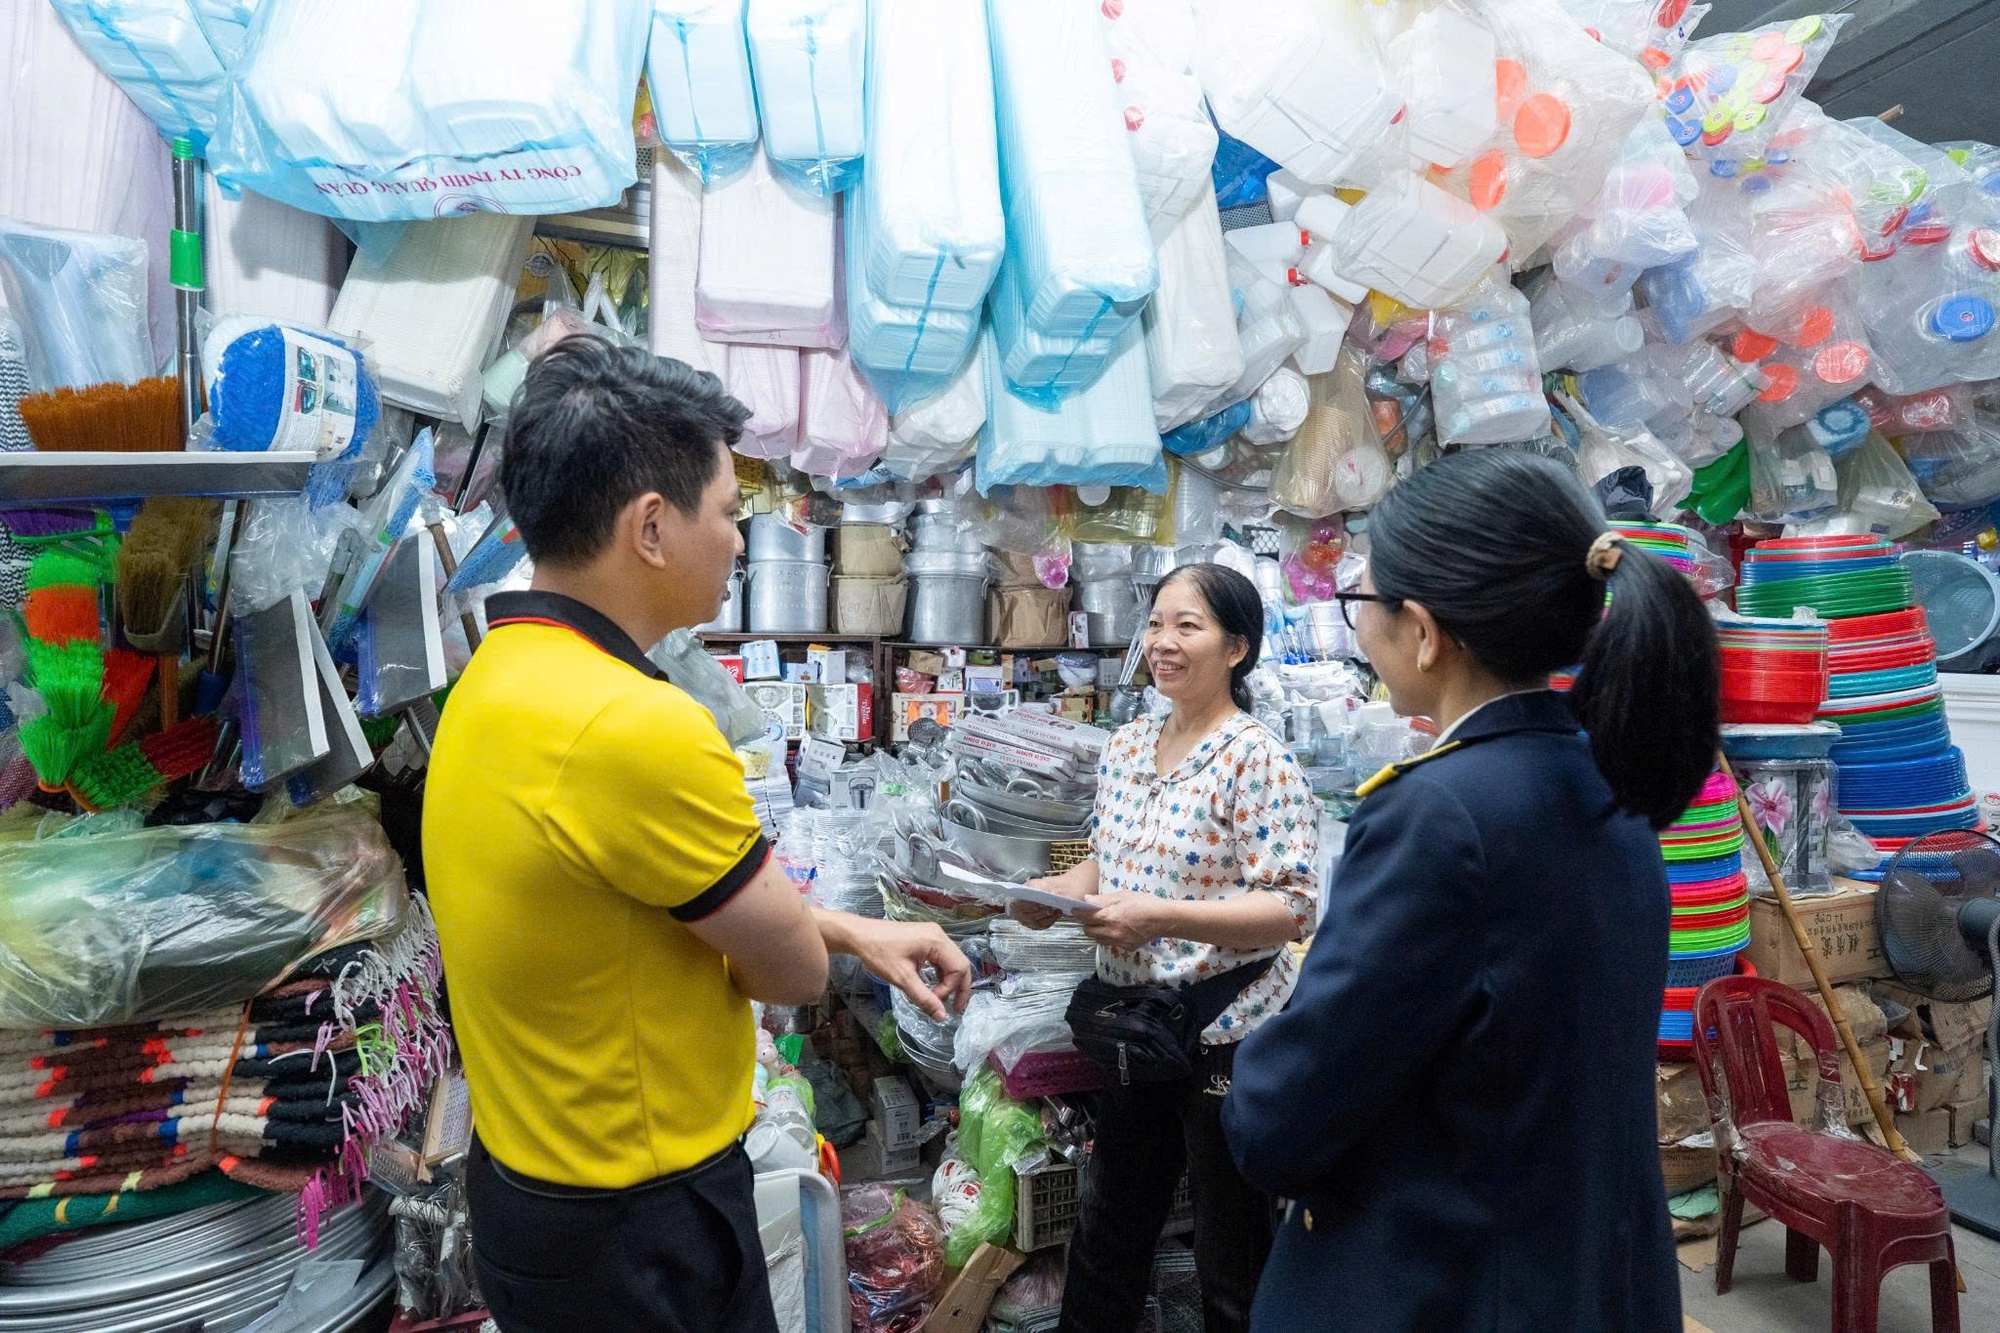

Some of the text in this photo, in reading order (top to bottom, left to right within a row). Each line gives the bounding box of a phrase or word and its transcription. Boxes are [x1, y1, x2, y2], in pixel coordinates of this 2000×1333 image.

[439, 170, 497, 188] TNHH
[498, 168, 525, 183] TY
[528, 164, 582, 181] CÔNG
